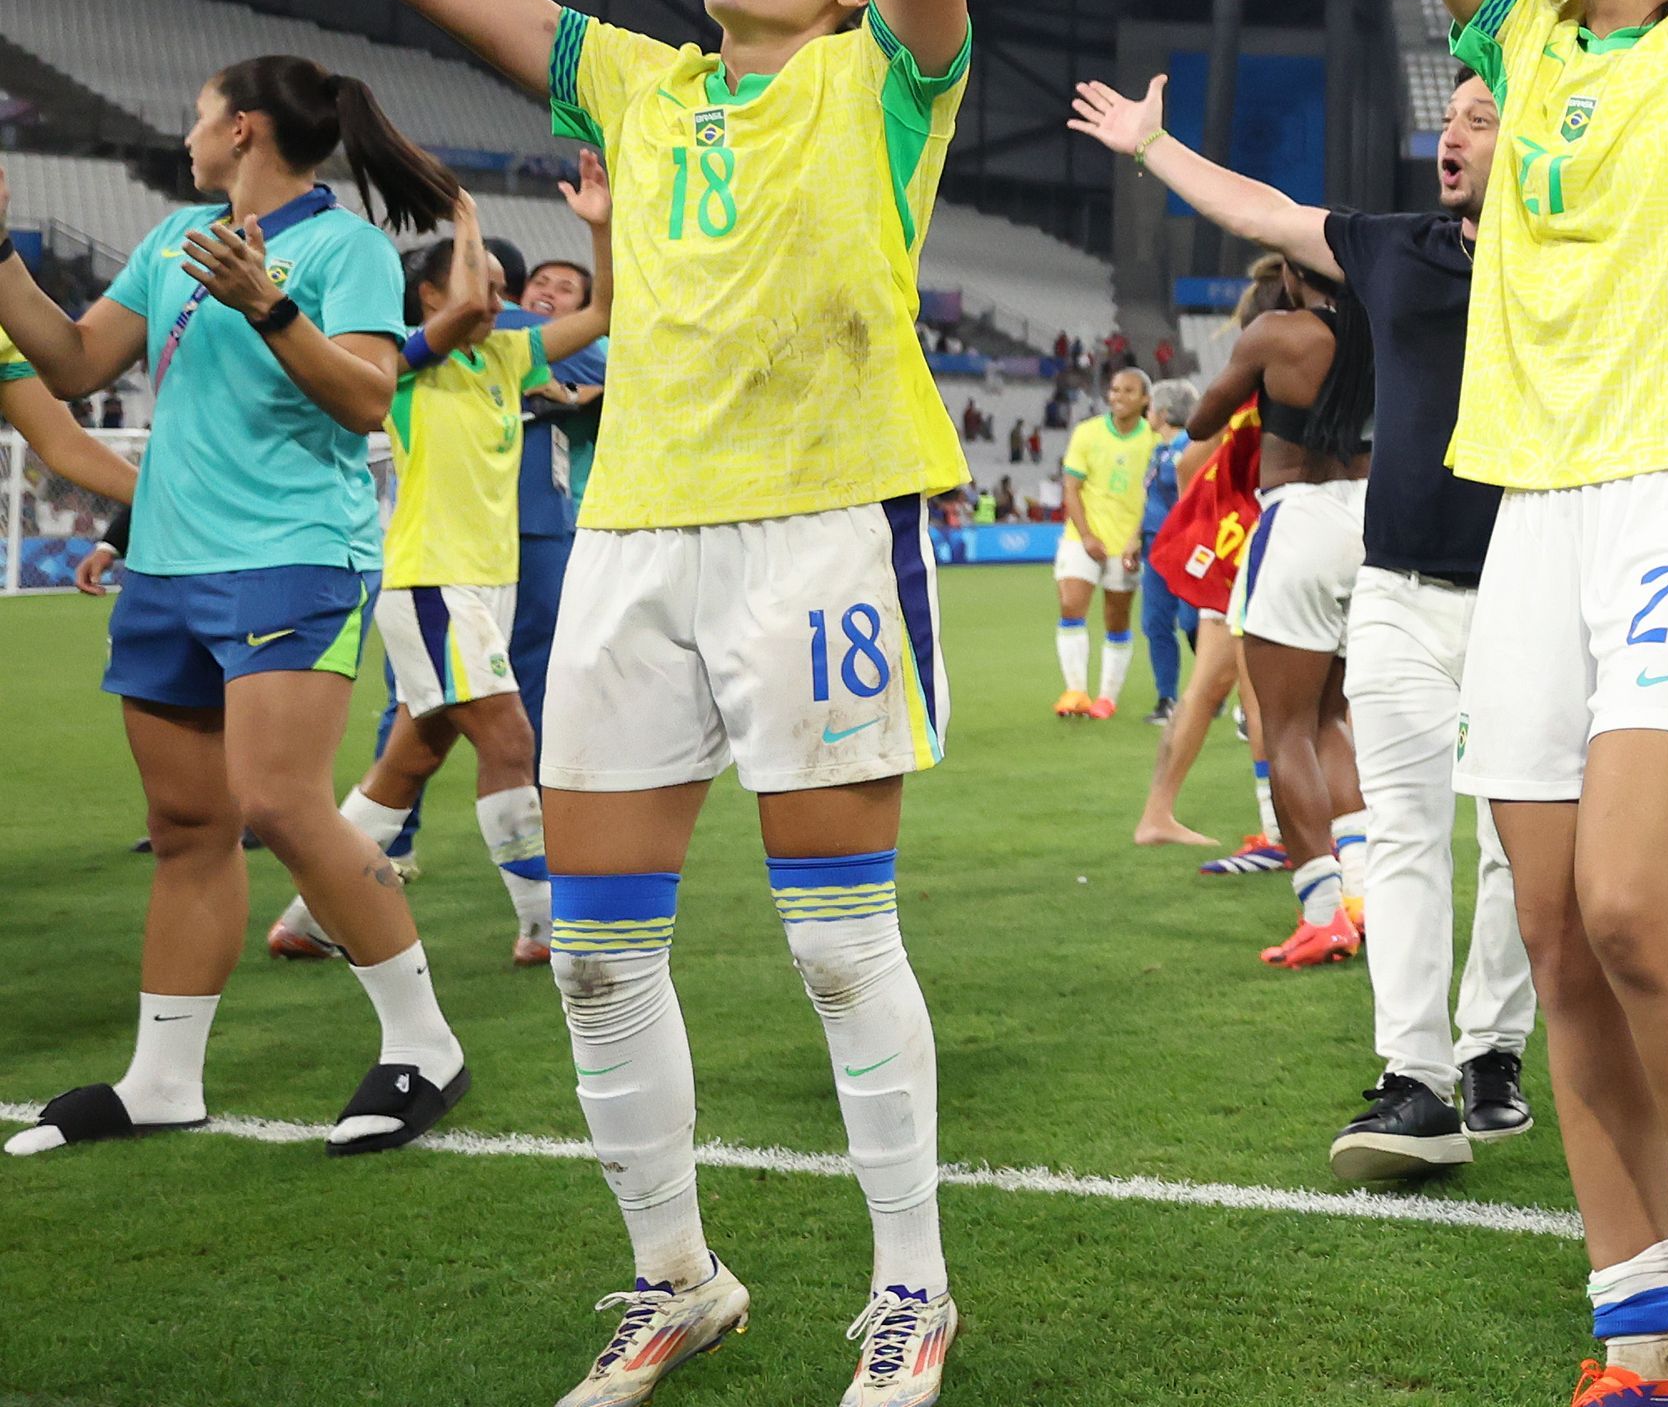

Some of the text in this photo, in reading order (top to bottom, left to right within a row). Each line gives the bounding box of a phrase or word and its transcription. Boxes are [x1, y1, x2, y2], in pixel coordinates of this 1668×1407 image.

[695, 111, 724, 123] BRASIL
[668, 146, 738, 240] 18
[808, 602, 891, 702] 18
